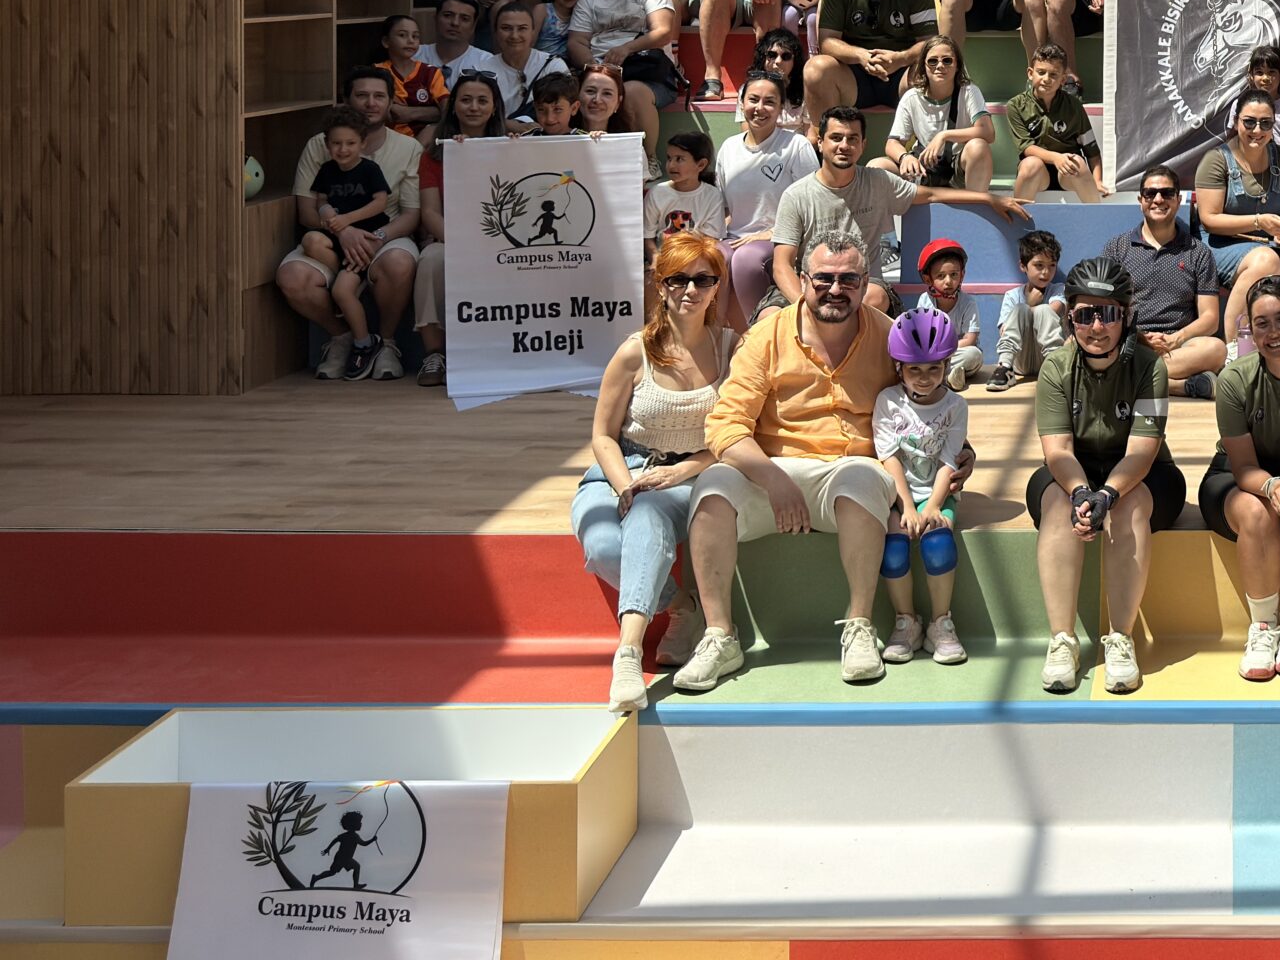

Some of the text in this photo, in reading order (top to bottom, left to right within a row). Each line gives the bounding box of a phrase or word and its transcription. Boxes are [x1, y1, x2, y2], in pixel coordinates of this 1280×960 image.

[496, 250, 592, 266] Campus Maya
[457, 296, 632, 325] Campus Maya
[512, 328, 584, 356] Koleji
[257, 896, 412, 927] Campus Maya
[286, 922, 385, 935] Montessori Primary School
